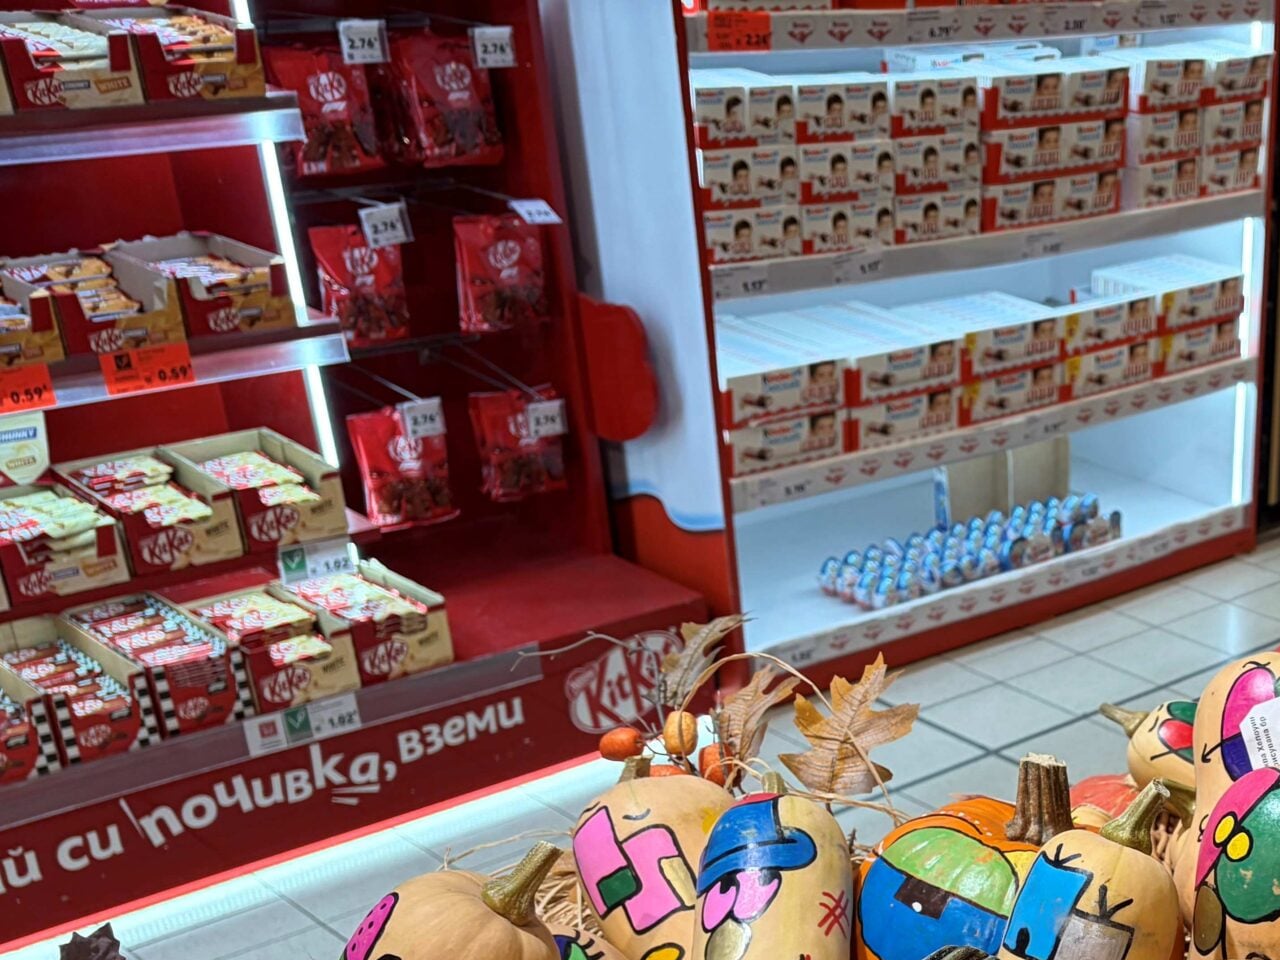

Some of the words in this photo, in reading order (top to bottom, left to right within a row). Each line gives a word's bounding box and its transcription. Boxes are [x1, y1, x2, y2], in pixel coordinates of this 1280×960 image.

[158, 367, 190, 382] 0.59
[10, 387, 42, 405] 0.59
[0, 427, 35, 441] HUNKY
[252, 507, 300, 541] KitKat
[143, 529, 193, 564] KitKat
[365, 640, 409, 675] KitKat
[263, 667, 311, 702] KitKat
[0, 847, 43, 896] й
[56, 823, 124, 871] си
[136, 743, 398, 848] почивка,
[397, 697, 525, 763] вземи
